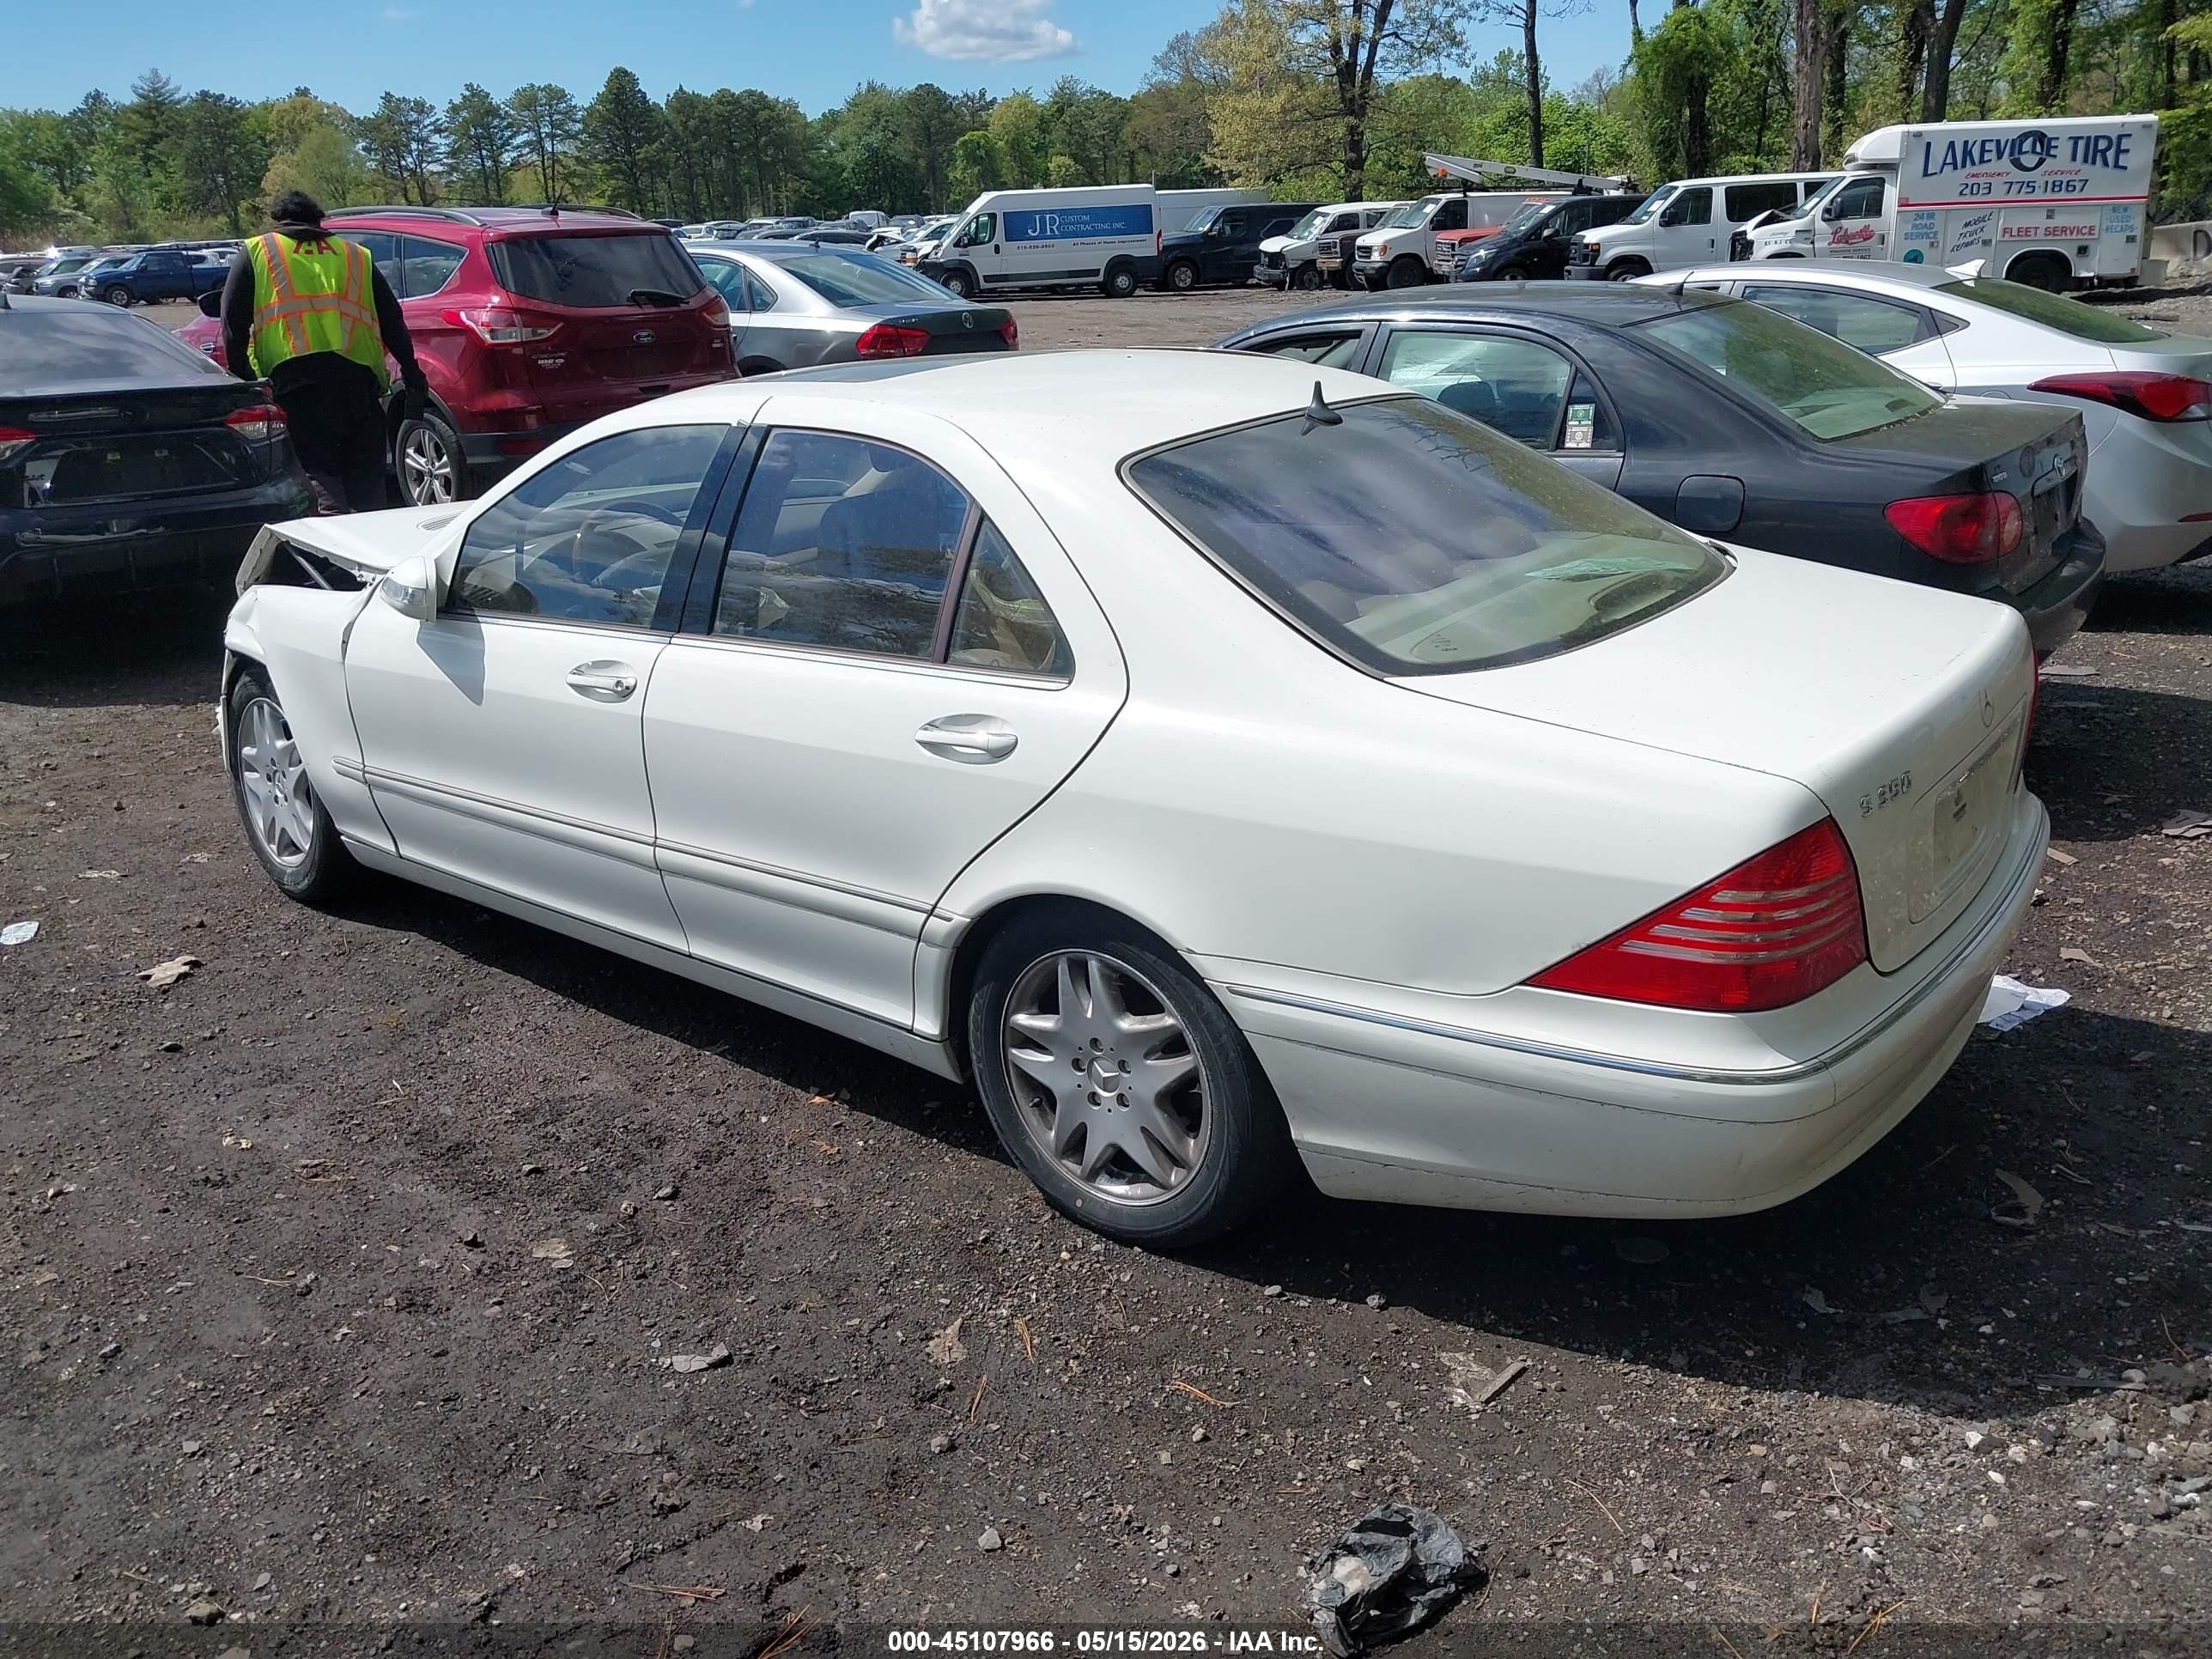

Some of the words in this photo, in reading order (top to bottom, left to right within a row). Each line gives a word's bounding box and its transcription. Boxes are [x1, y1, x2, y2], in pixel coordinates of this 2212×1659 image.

[1922, 136, 2061, 178] LAKEVILLE
[2069, 133, 2133, 171] TIRE
[1964, 171, 2012, 179] EMERGENCY
[1958, 182, 1993, 196] 203
[2112, 205, 2130, 214] NEW
[1060, 215, 1090, 223] CUSTOM
[1961, 211, 1994, 229] MOBILE
[2109, 215, 2130, 223] USED
[1060, 222, 1111, 232] CONTRACTING
[1911, 222, 1935, 231] ROAD
[2002, 227, 2040, 238] FLEET
[2044, 225, 2096, 237] SERVICE
[1903, 231, 1939, 241] SERVICE
[1957, 224, 1988, 240] TRUCK
[1860, 794, 1873, 817] S
